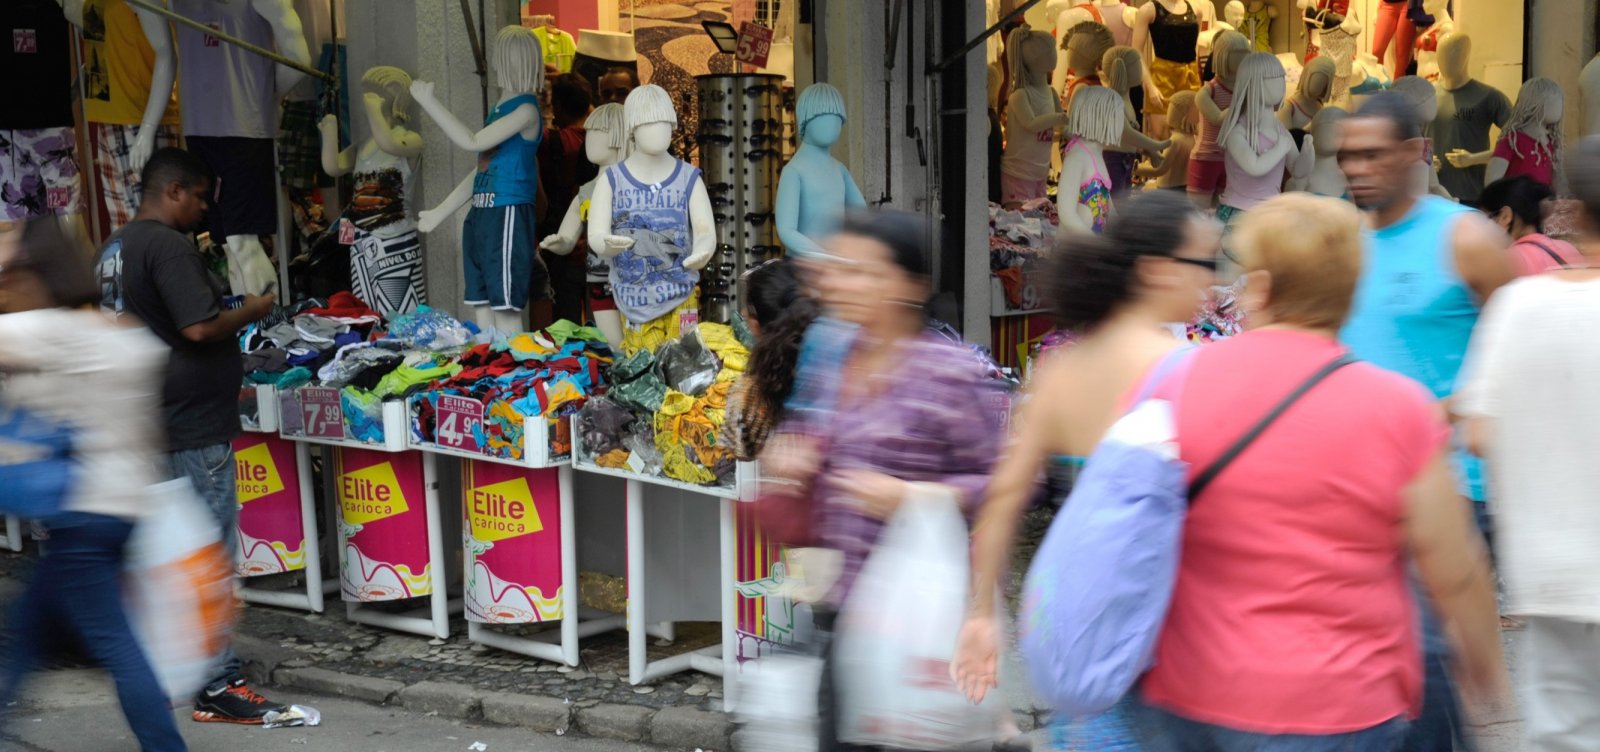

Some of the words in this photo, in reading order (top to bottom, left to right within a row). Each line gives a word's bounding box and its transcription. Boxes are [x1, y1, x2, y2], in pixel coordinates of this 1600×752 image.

[737, 34, 769, 62] 5,99
[306, 389, 334, 398] Elite
[444, 397, 474, 410] Elite
[305, 403, 340, 435] 7,99
[235, 459, 267, 482] lite
[236, 483, 269, 494] rioca
[343, 475, 391, 502] Elite
[344, 501, 392, 515] carioca
[474, 490, 525, 520] Elite
[474, 517, 525, 533] carioca
